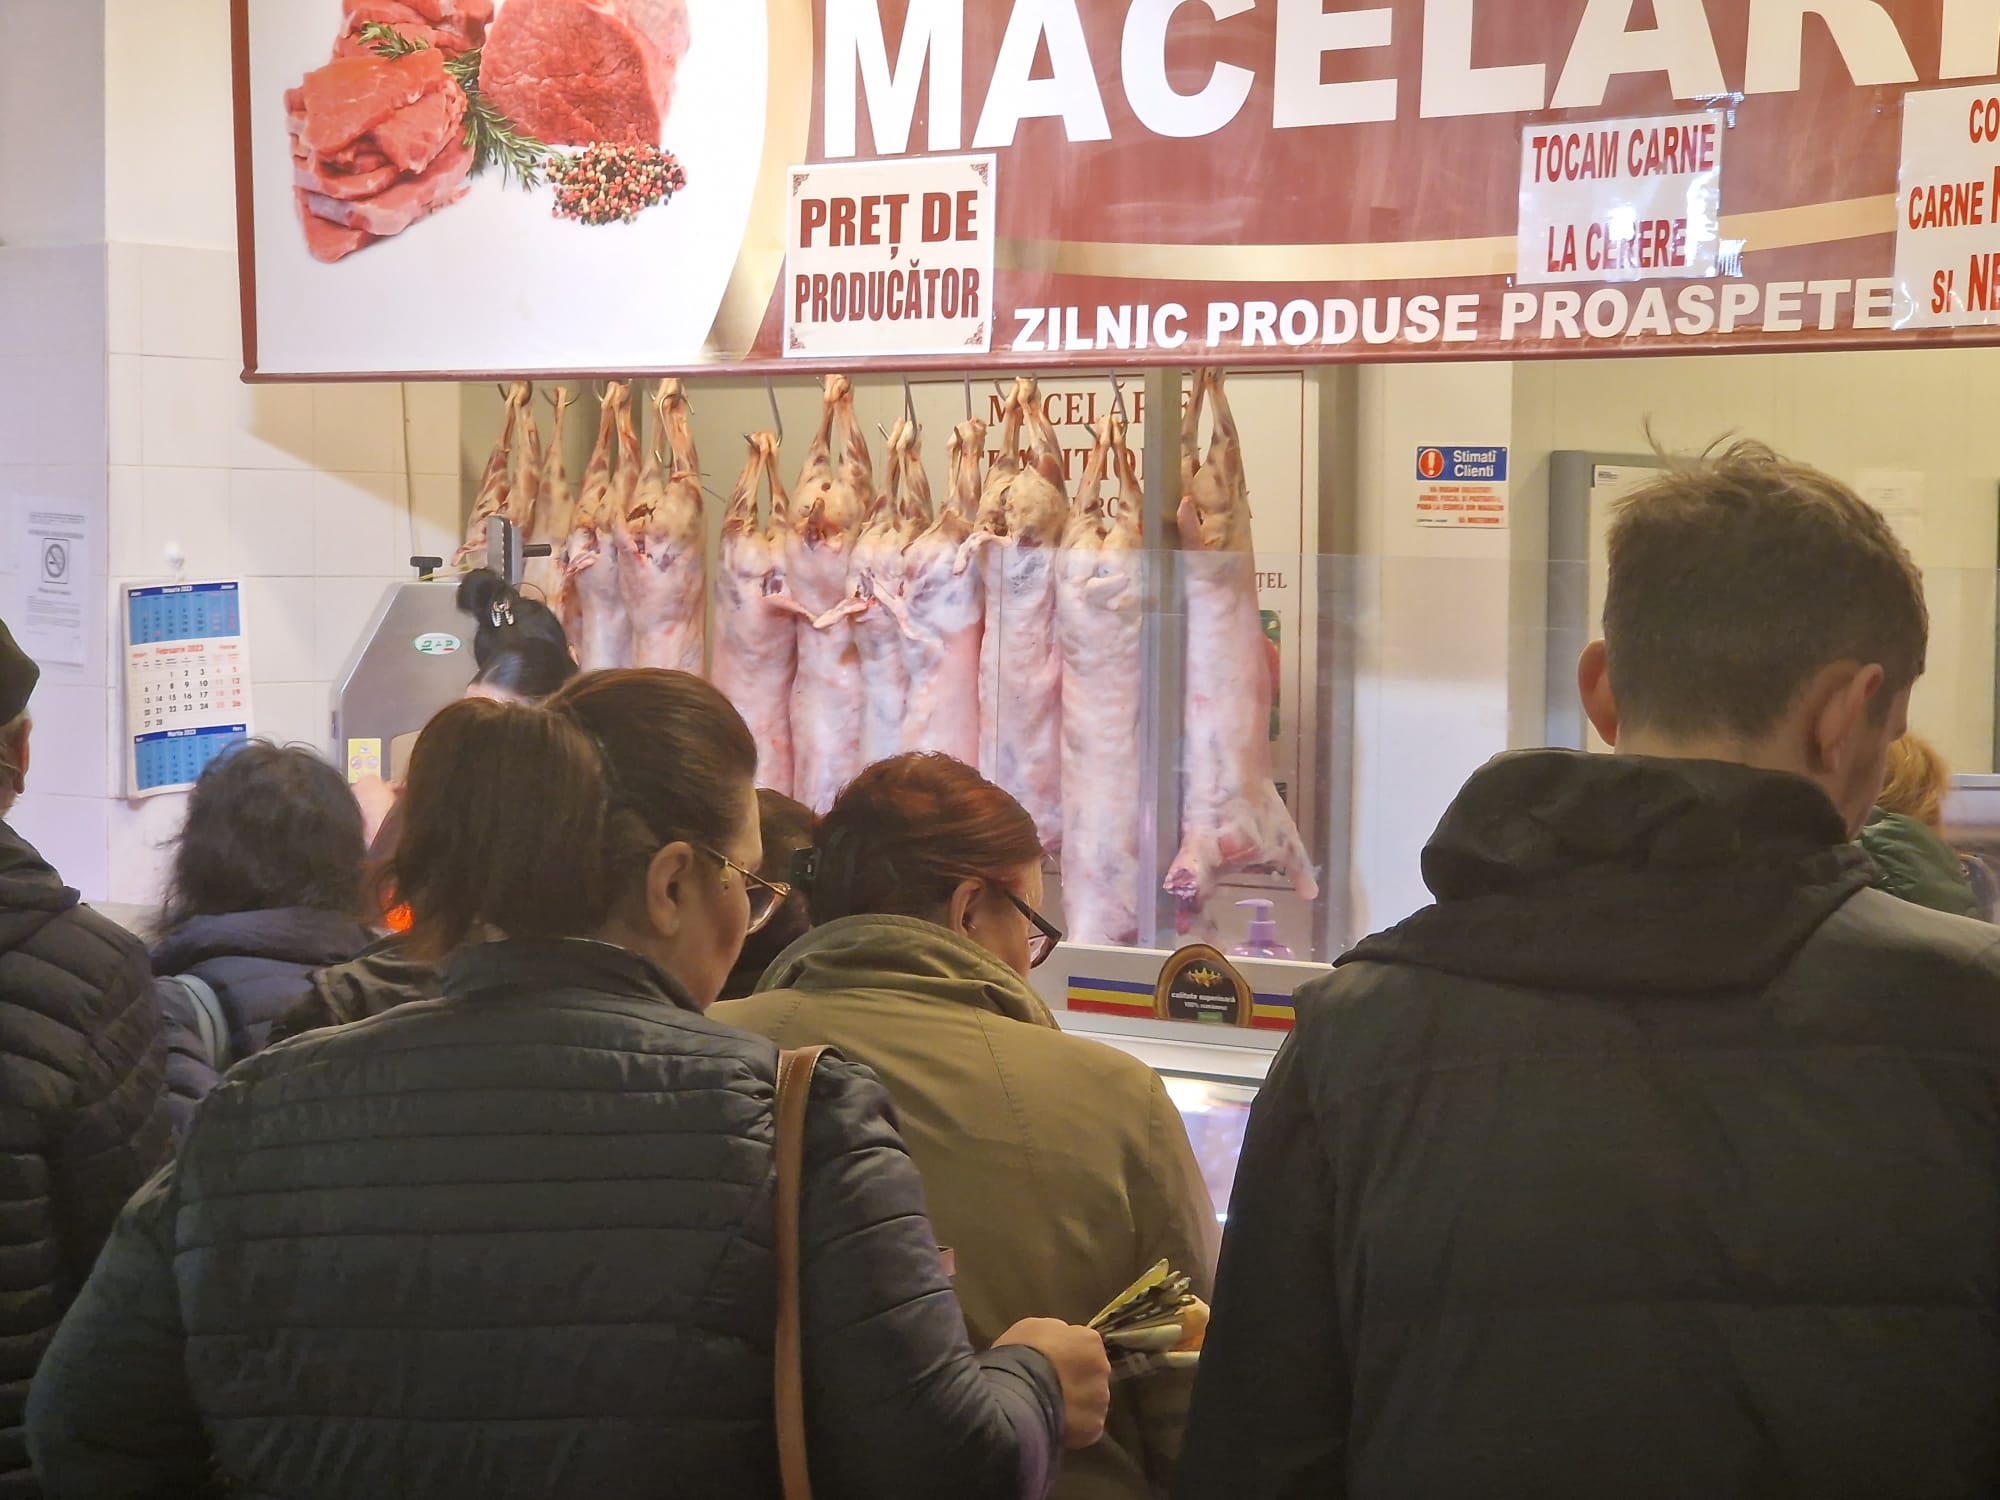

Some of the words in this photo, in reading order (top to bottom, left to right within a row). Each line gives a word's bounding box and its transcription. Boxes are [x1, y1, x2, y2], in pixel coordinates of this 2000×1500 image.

[1532, 131, 1619, 183] TOCAM
[1627, 123, 1716, 178] CARNE
[800, 193, 910, 260] PREȚ
[921, 189, 978, 243] DE
[1908, 180, 1985, 230] CARNE
[1547, 223, 1577, 273] LA
[1585, 218, 1688, 272] CERERE
[795, 258, 980, 323] PRODUCĂTOR
[1011, 302, 1189, 352] ZILNIC
[1205, 294, 1481, 348] PRODUSE
[1499, 277, 1893, 341] PROASPETE
[1931, 269, 1954, 314] SI
[200, 668, 205, 676] 3
